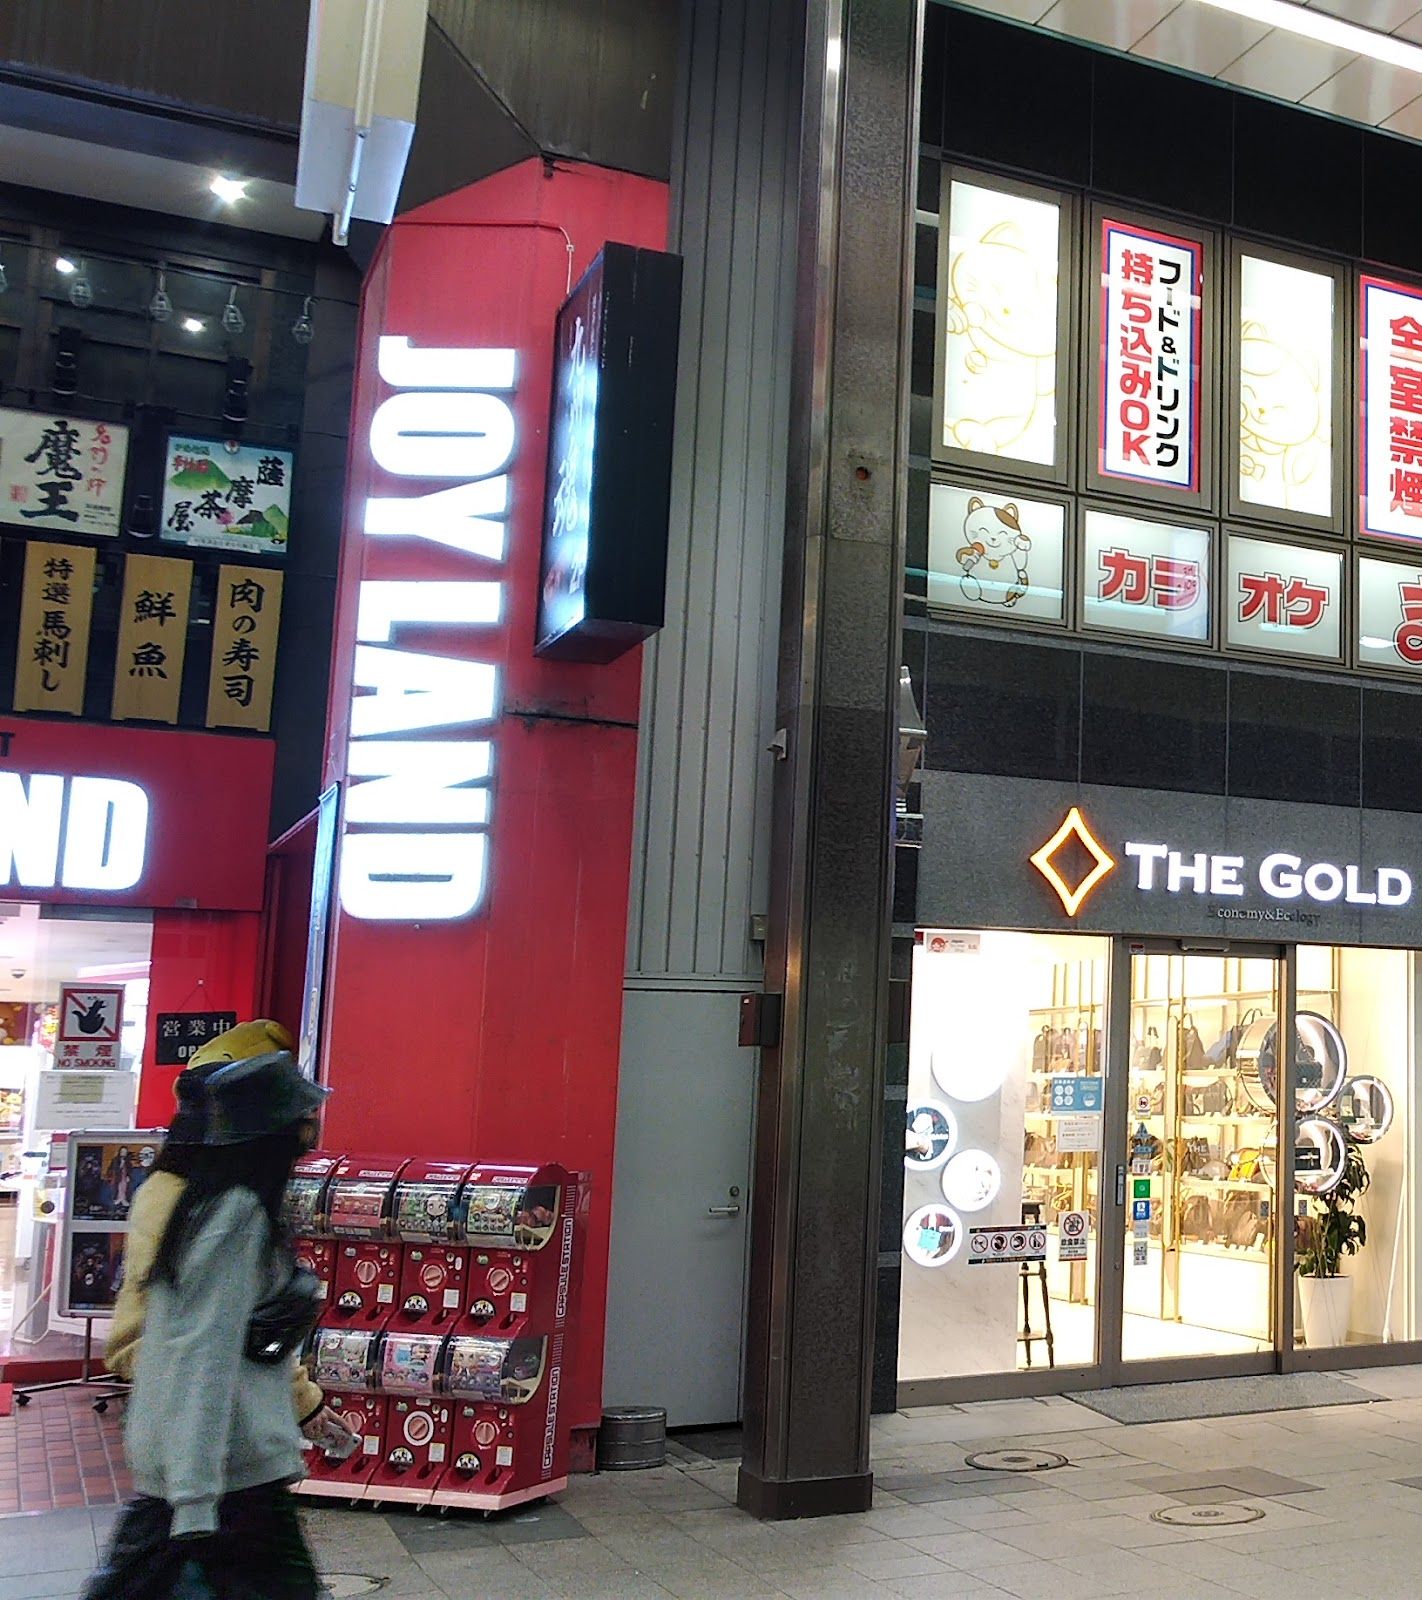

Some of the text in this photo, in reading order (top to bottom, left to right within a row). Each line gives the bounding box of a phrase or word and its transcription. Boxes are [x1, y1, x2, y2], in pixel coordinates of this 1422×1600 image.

[1119, 248, 1155, 466] 持ち込みOK
[19, 420, 83, 523] 魔王
[167, 456, 286, 533] 薩摩茶屋
[33, 558, 74, 693] 特選馬刺し
[128, 590, 177, 680] 鮮魚
[222, 578, 265, 708] 肉の寿司
[338, 334, 517, 921] JOYLAND
[1124, 841, 1244, 897] THE
[58, 1058, 116, 1068] NO SMOKING
[63, 1044, 113, 1058] 禁煙
[177, 1045, 204, 1059] OP
